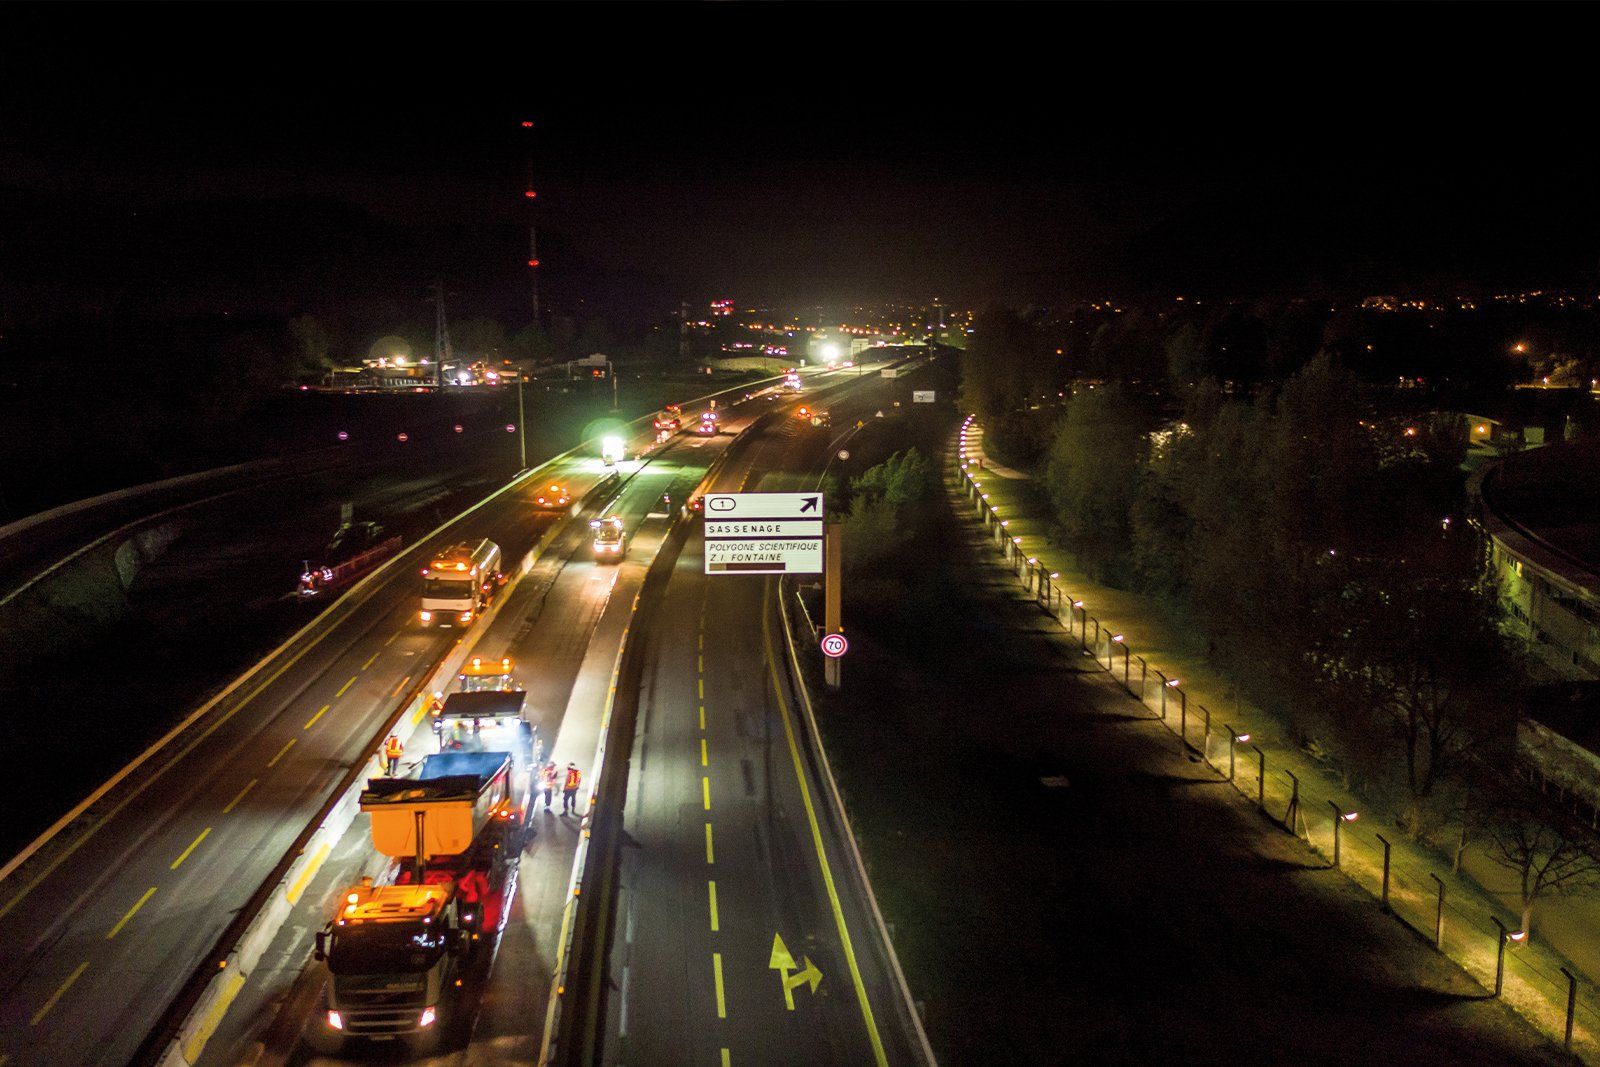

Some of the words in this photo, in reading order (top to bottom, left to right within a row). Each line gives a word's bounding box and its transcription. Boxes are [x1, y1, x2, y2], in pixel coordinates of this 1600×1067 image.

[708, 525, 781, 534] SASSENAGE
[709, 543, 755, 552] POLYGONE
[758, 542, 818, 551] SCIENTIFIQUE
[731, 553, 782, 562] FONTAINE
[828, 640, 842, 650] 70
